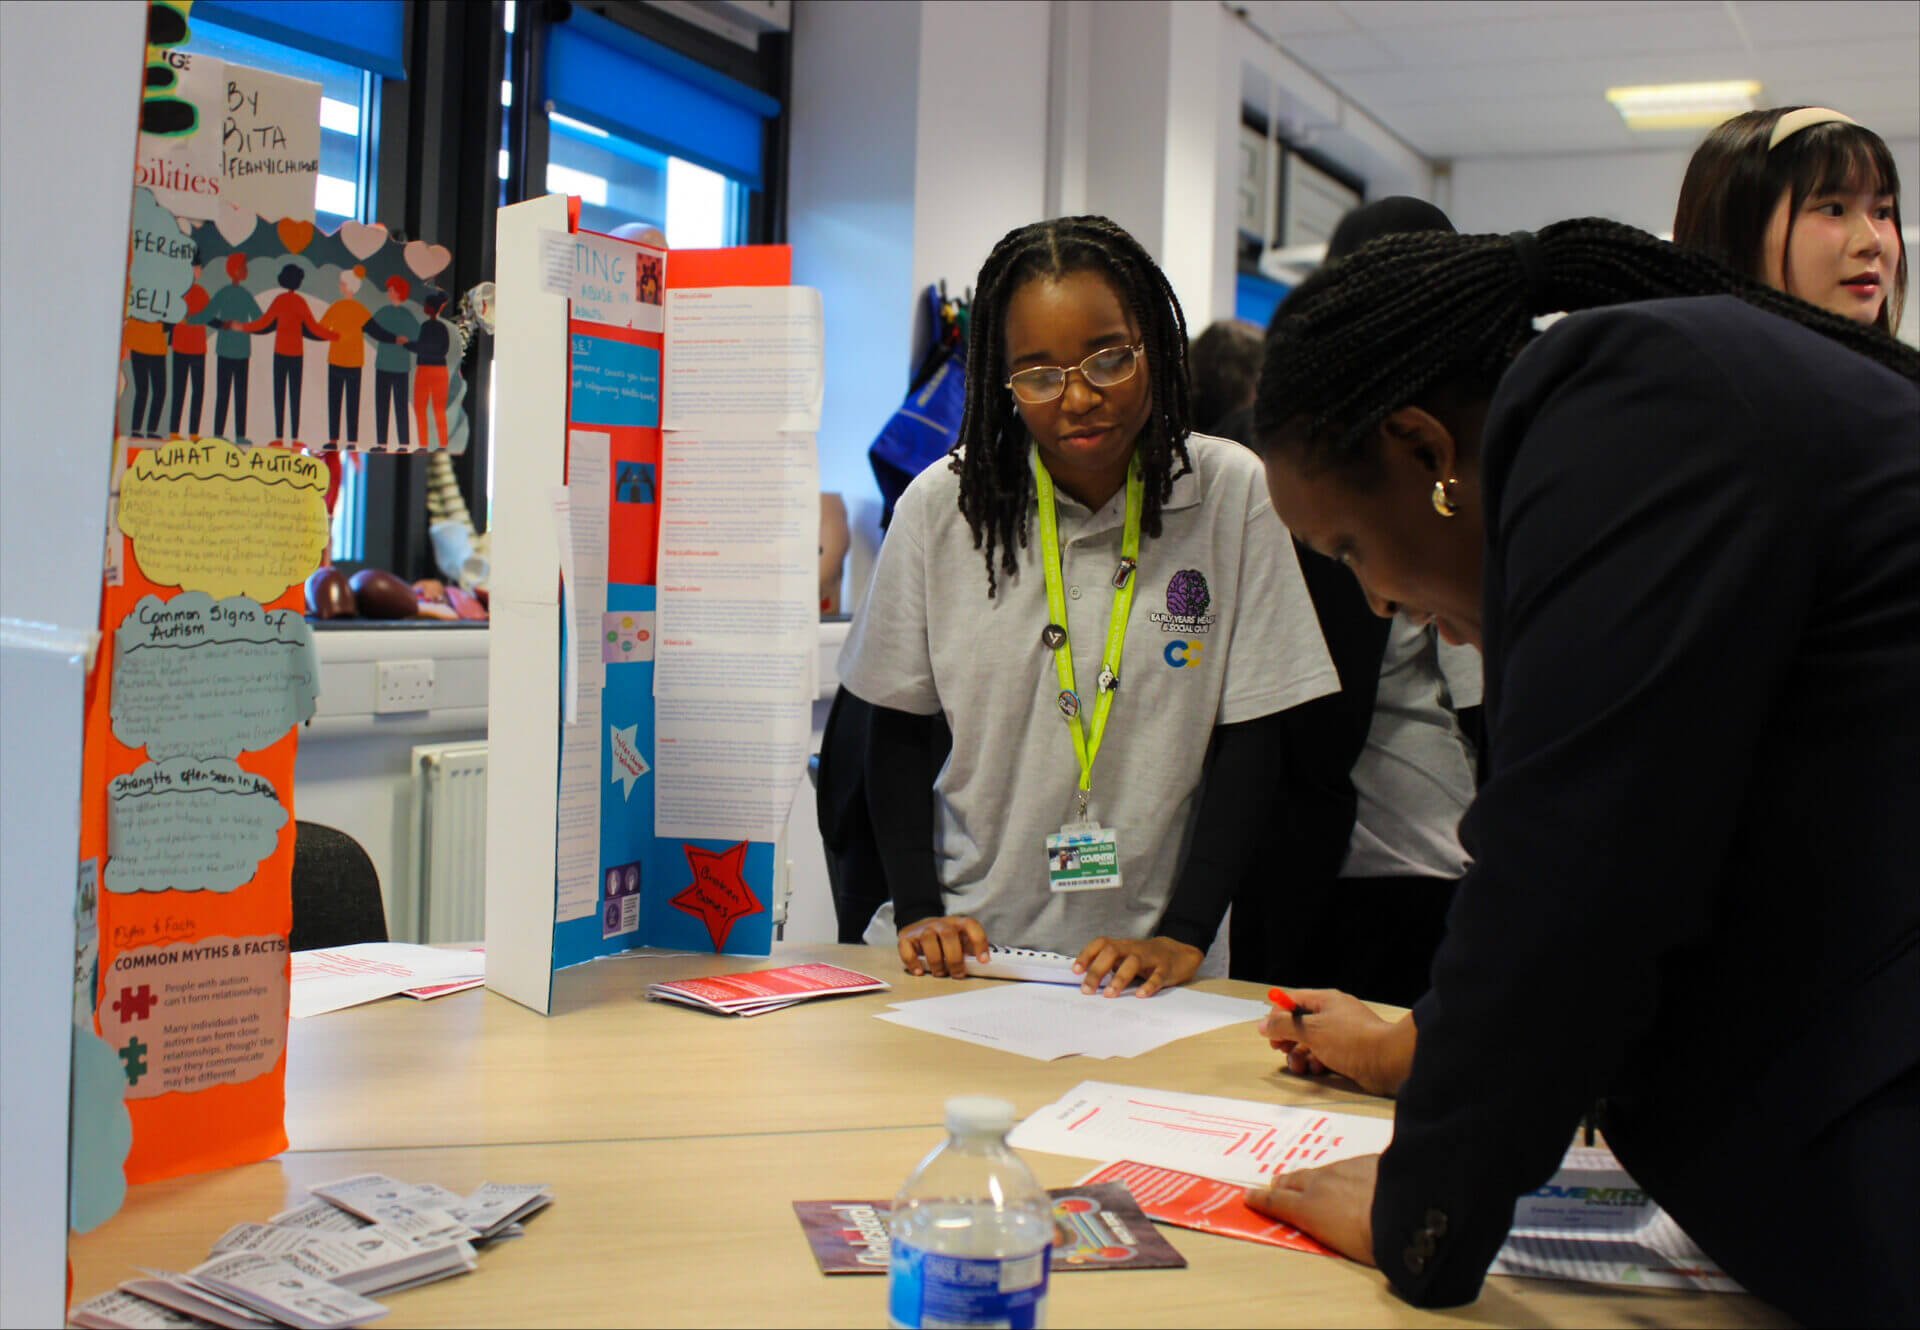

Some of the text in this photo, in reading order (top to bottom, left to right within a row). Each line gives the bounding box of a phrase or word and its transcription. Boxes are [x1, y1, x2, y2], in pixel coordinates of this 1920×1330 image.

[154, 446, 215, 467] WHAT
[226, 451, 240, 468] IS
[139, 605, 288, 633] Common Signs of
[1151, 613, 1173, 623] EARLY
[1173, 615, 1196, 624] YEARS
[1169, 624, 1193, 633] SOCIAL
[150, 623, 205, 641] Autism
[115, 939, 286, 971] COMMON MYTHS & FACTS
[164, 975, 248, 993] People with autism
[163, 986, 267, 1007] can't form relationships
[163, 1013, 260, 1035] Many individuals with
[163, 1027, 259, 1048] autism can form close
[259, 1038, 274, 1046] the
[163, 1052, 264, 1075] way they communicate
[162, 1068, 236, 1089] may be different
